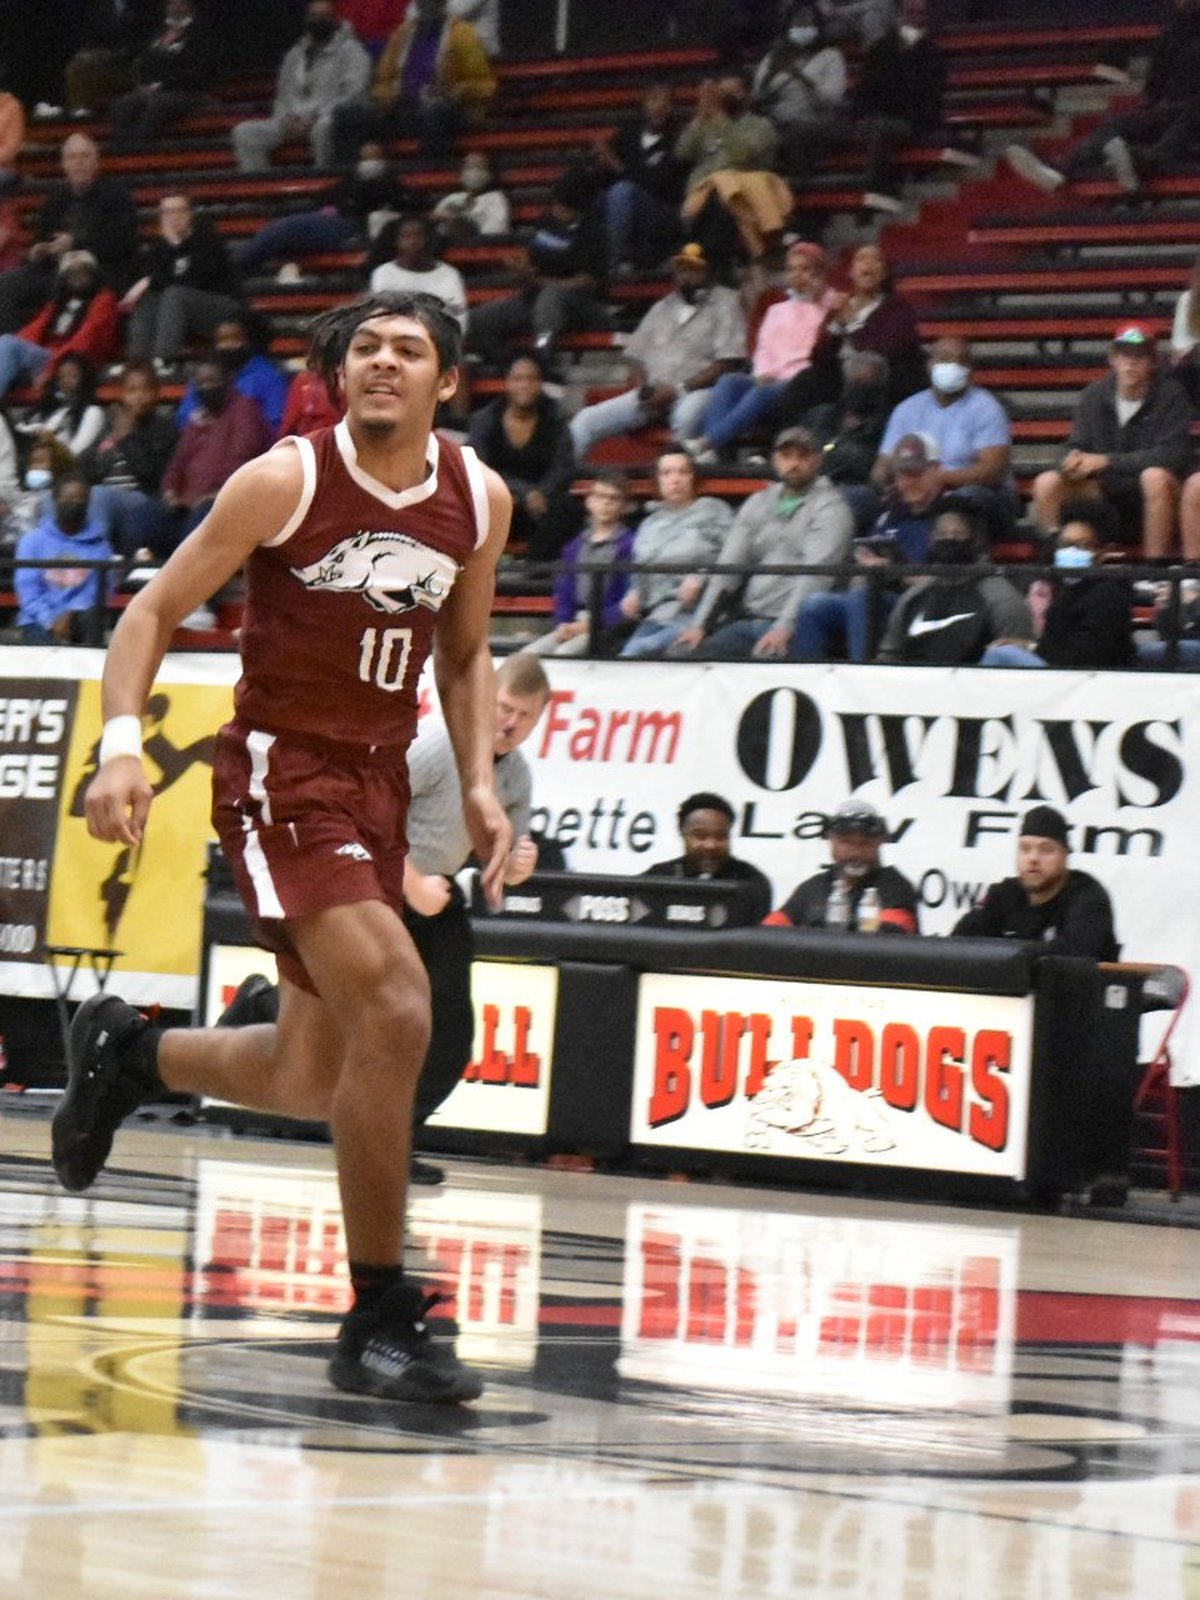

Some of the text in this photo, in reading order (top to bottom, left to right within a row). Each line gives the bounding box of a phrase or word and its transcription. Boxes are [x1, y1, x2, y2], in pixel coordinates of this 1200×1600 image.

[359, 627, 413, 692] 10
[538, 690, 683, 764] Farm
[735, 686, 1184, 808] OWENS
[529, 798, 656, 853] nette
